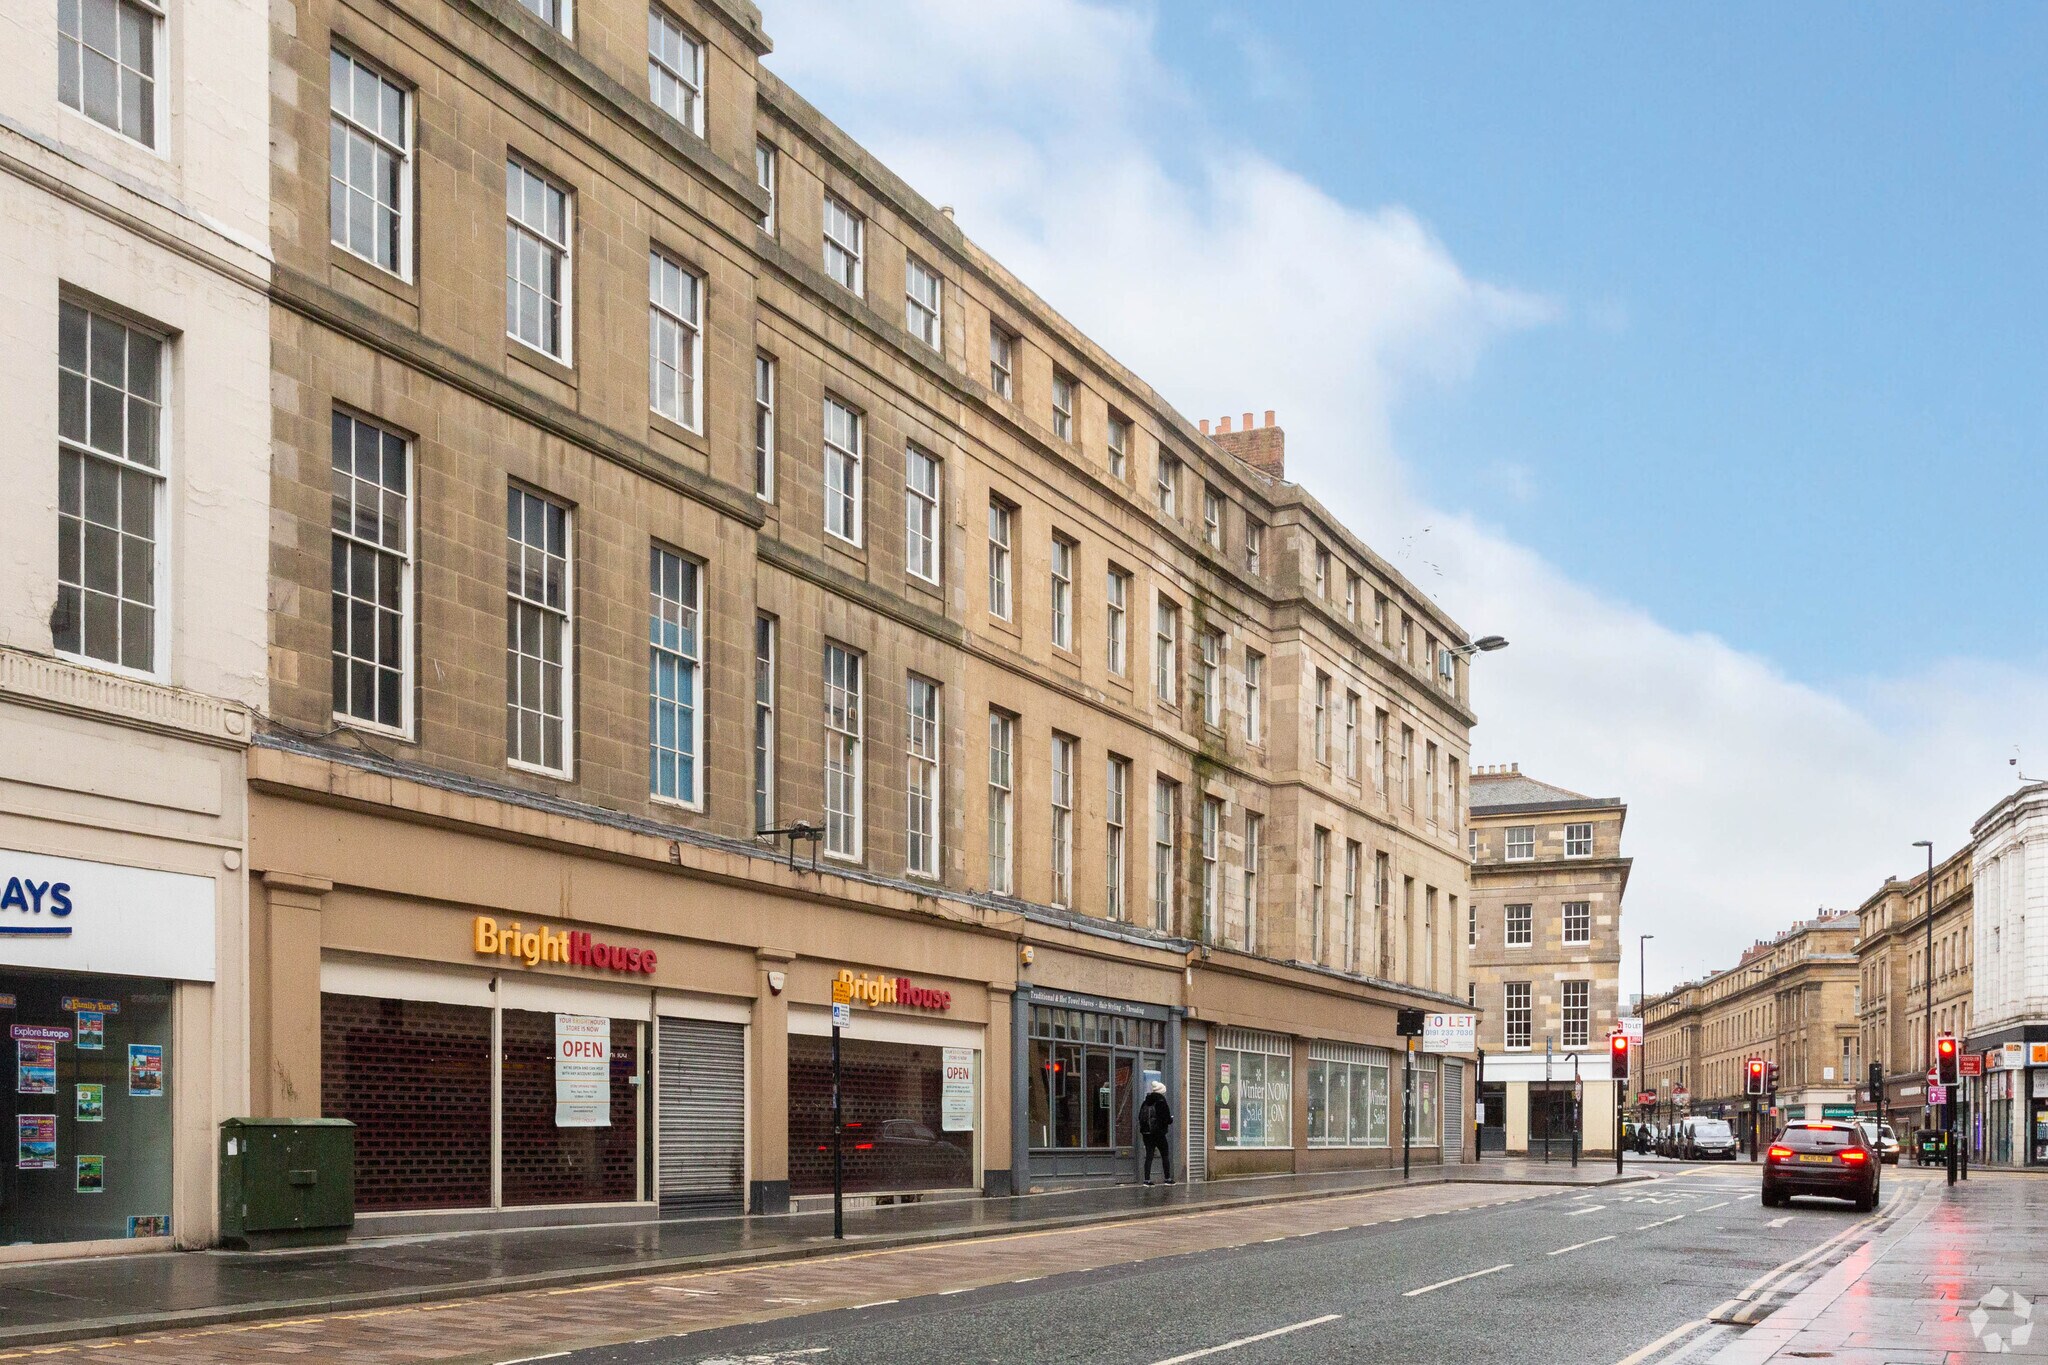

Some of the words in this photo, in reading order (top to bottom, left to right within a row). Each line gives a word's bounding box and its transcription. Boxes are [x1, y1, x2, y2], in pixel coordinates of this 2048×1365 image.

[0, 876, 72, 917] AYS
[474, 915, 658, 974] BrightHouse
[1030, 990, 1055, 1002] Traditional
[1059, 994, 1067, 1003] Hot
[1067, 996, 1080, 1005] Towel
[1080, 998, 1094, 1007] Shaves
[1098, 1000, 1107, 1009] Hair
[1108, 1002, 1121, 1012] Styling
[1125, 1004, 1144, 1015] Threading
[1425, 1016, 1443, 1027] TO
[1448, 1016, 1473, 1027] LET
[14, 1027, 42, 1037] Explore
[42, 1028, 70, 1039] Europe
[562, 1040, 603, 1058] OPEN
[946, 1066, 969, 1080] OPEN
[1240, 1080, 1264, 1099] Winter
[1267, 1082, 1289, 1100] NOW
[1369, 1089, 1387, 1106] Winter
[1246, 1102, 1263, 1121] Sale
[1271, 1103, 1285, 1122] ON
[1373, 1108, 1386, 1125] Sale
